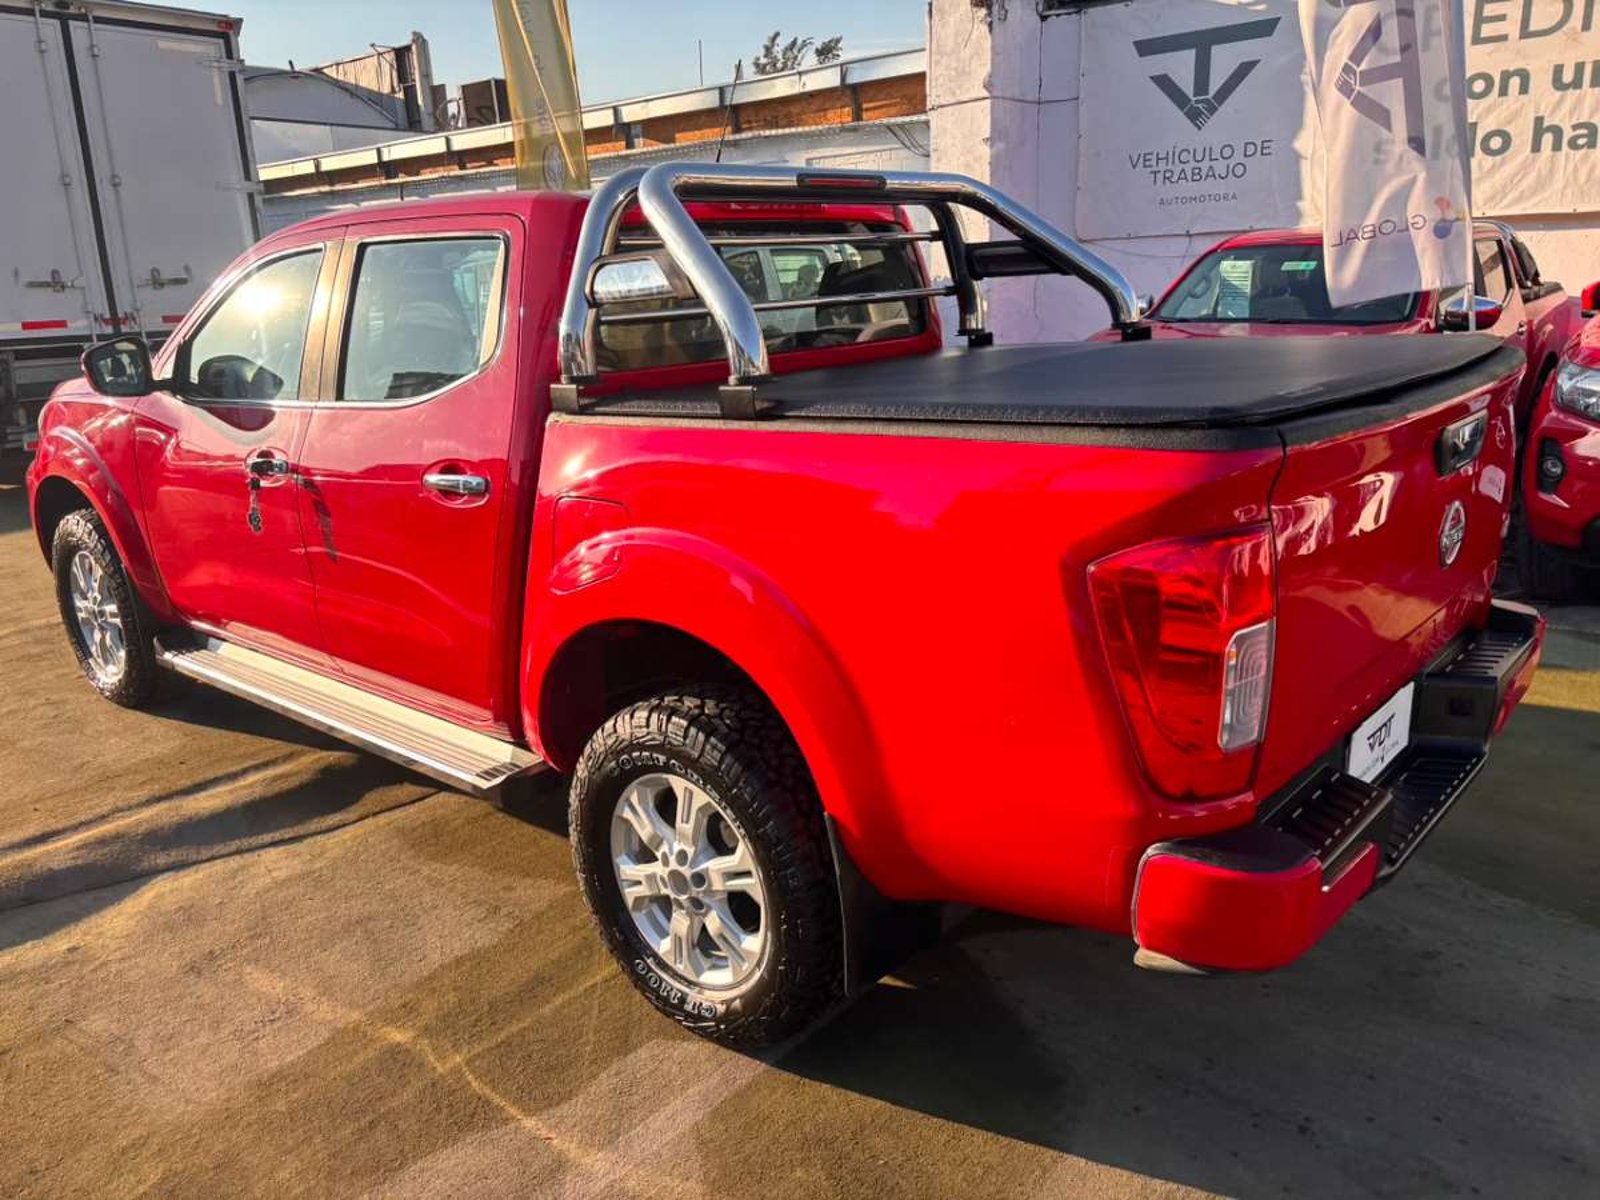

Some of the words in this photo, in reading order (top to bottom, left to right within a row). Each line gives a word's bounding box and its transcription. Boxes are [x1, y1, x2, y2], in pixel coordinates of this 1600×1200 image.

[1128, 143, 1235, 170] VEHÍCULO
[1243, 139, 1273, 159] DE
[1150, 162, 1248, 186] TRABAJO
[1158, 192, 1238, 206] AUTOMOTORA
